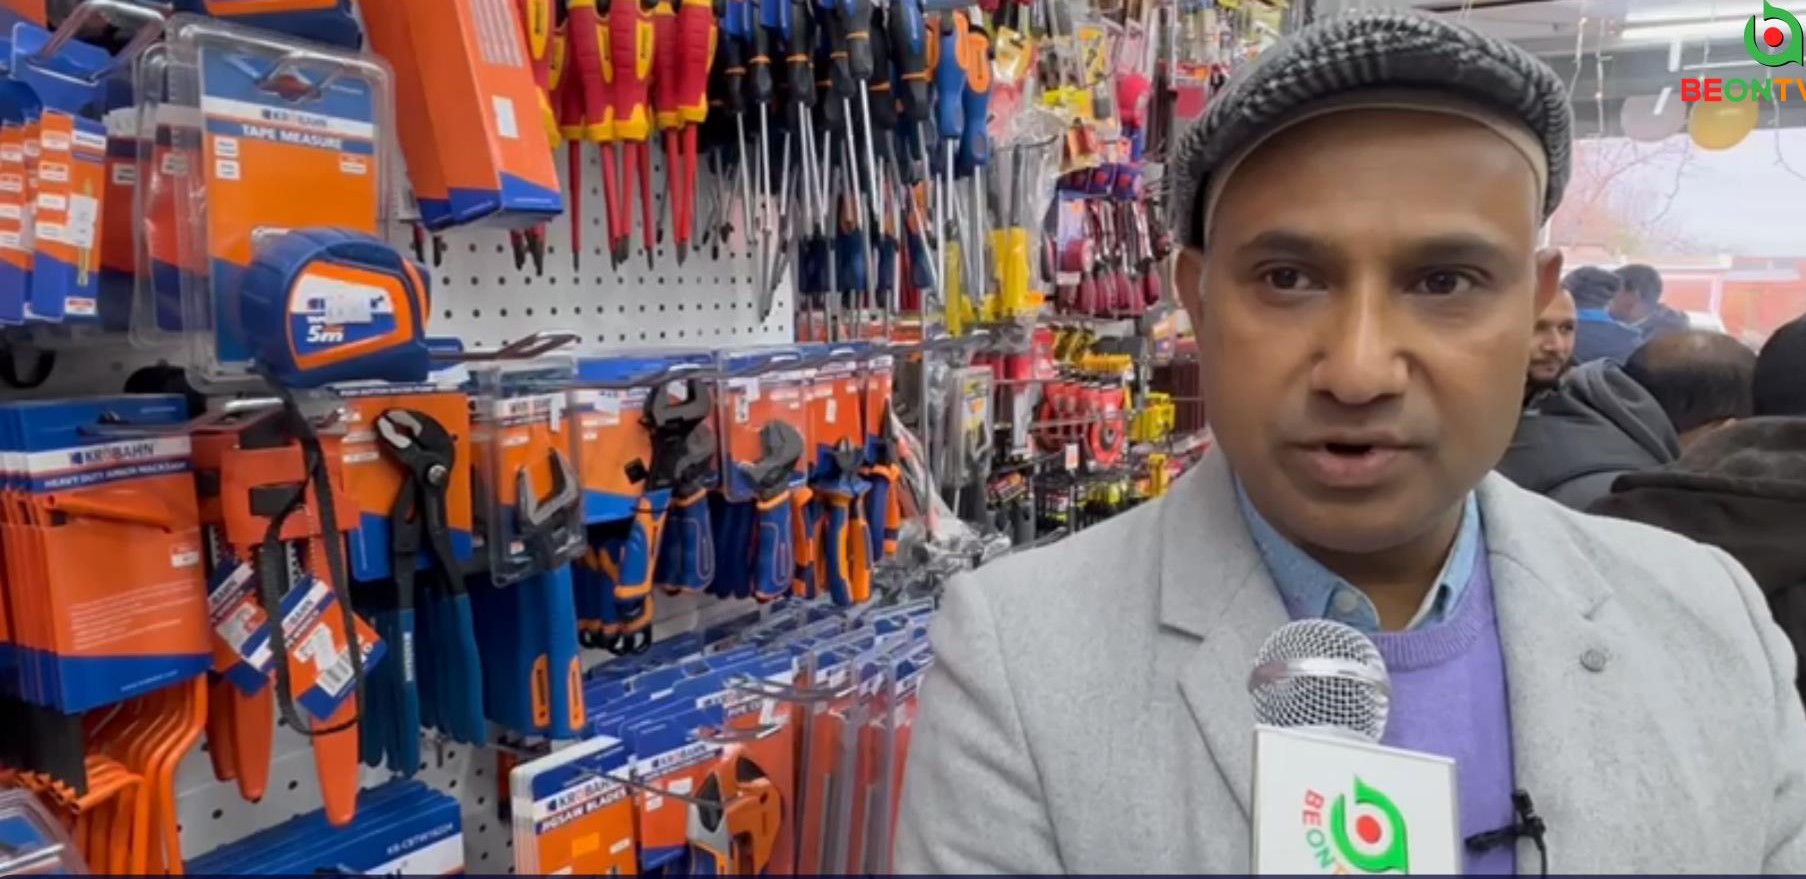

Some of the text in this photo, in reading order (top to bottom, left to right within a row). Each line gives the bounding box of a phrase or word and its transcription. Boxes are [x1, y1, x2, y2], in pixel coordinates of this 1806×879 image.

[241, 123, 342, 150] TAPE MEASURE
[306, 324, 344, 343] 5m
[44, 476, 79, 488] HEAVY
[80, 472, 104, 483] DUTY
[541, 786, 627, 831] JIGSAW BLADES
